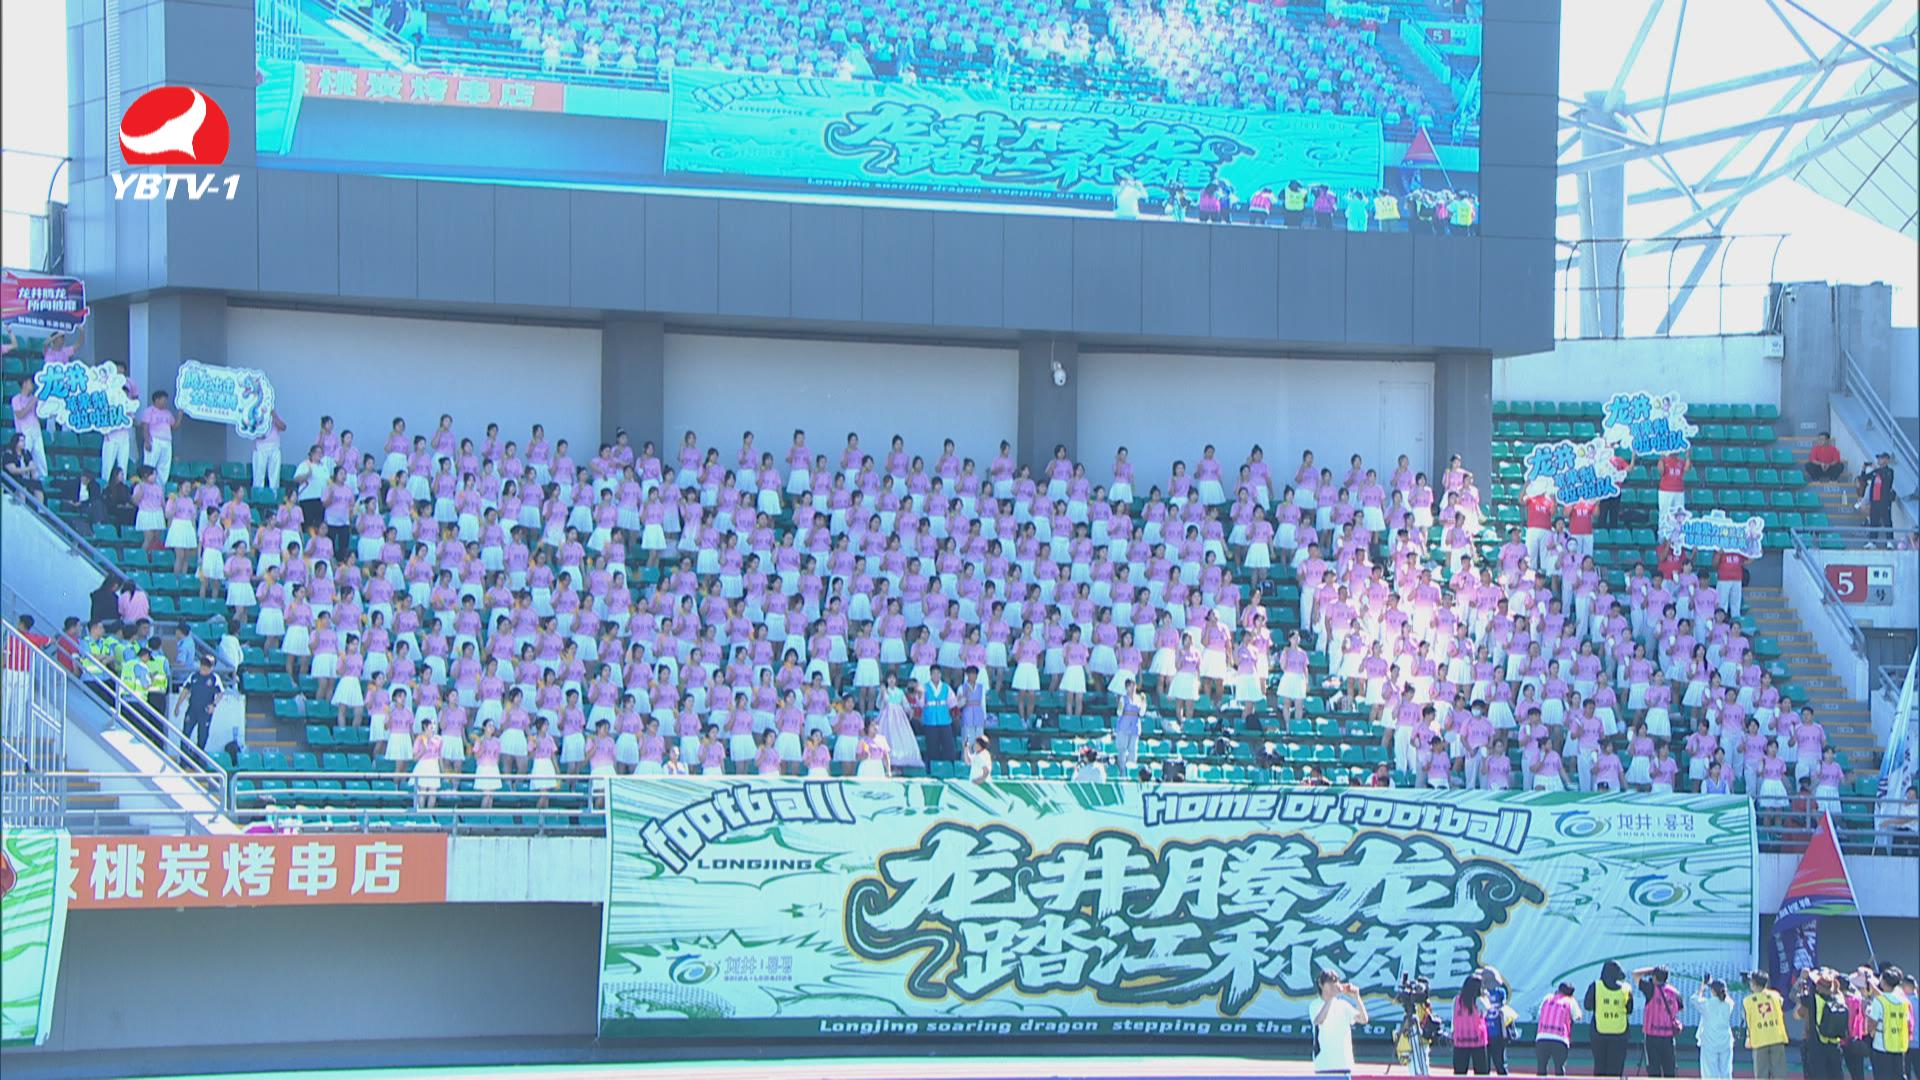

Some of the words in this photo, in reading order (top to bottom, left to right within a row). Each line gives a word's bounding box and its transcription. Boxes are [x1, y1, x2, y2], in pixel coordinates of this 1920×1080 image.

[37, 364, 89, 401] 龙井
[1606, 393, 1652, 428] 龙井
[1528, 442, 1577, 481] 龙井
[1837, 571, 1854, 596] 5
[639, 780, 856, 874] football
[1338, 794, 1532, 855] football
[697, 858, 812, 870] LONGJING
[860, 828, 1492, 932] 龙井腾龙
[950, 914, 1476, 1006] 踏江称雄
[819, 1019, 918, 1036] Longjing
[926, 1020, 1011, 1034] soaring
[1019, 1019, 1099, 1034] dragon
[1112, 1018, 1211, 1034] stepping
[1219, 1022, 1248, 1033] on
[1255, 1020, 1292, 1033] the
[1362, 1023, 1386, 1034] to
